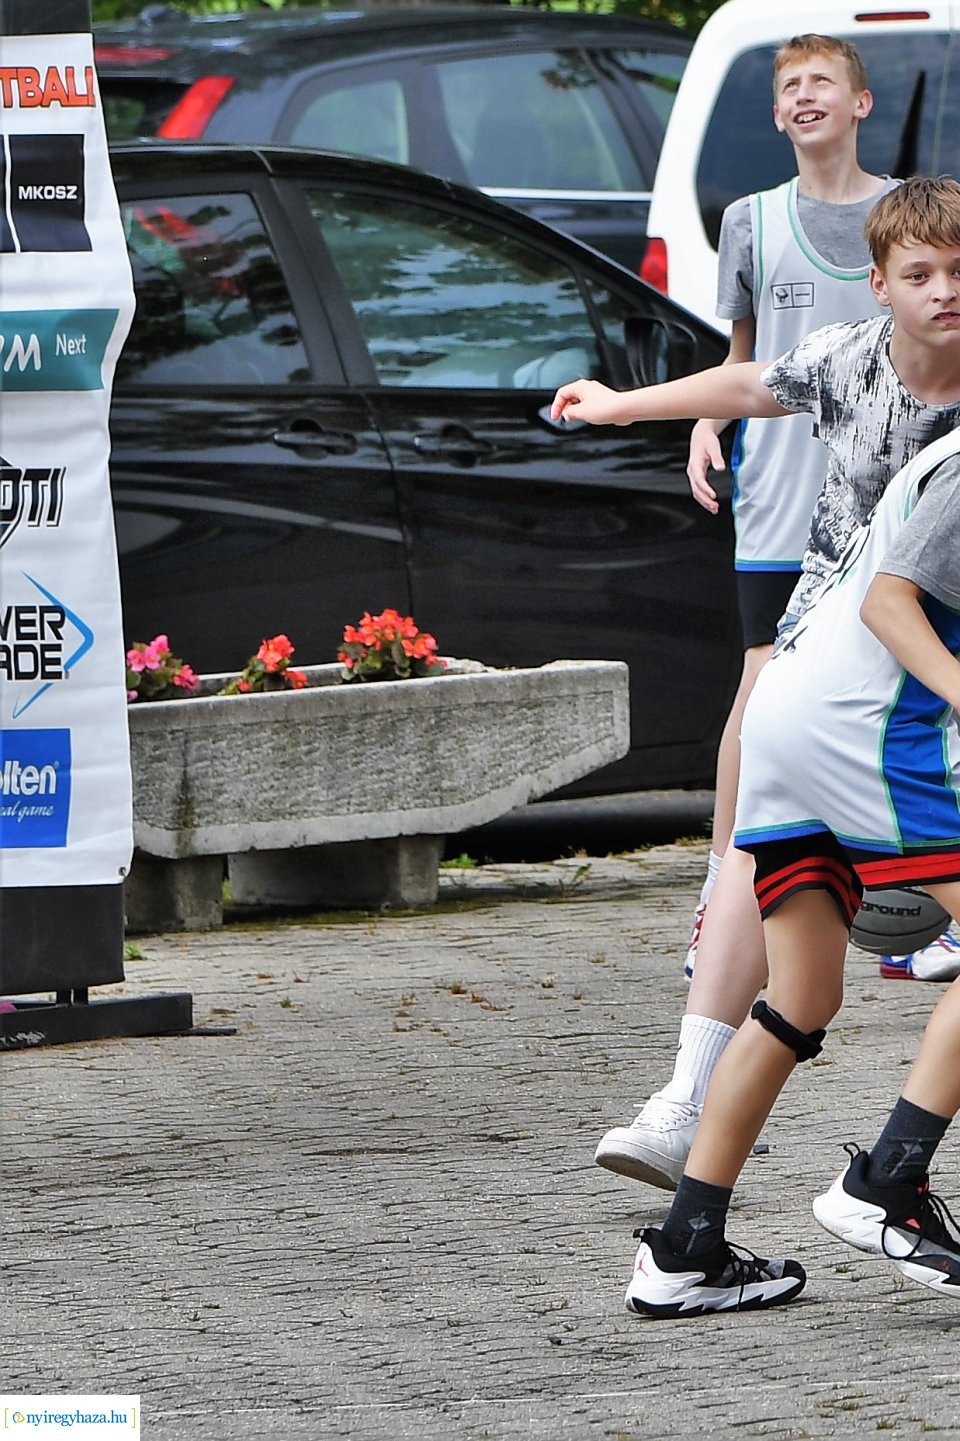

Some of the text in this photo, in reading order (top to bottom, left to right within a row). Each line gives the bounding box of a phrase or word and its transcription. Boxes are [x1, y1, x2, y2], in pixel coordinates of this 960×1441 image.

[18, 185, 78, 200] MKOSZ
[56, 333, 87, 356] Next
[17, 805, 55, 823] game
[861, 901, 922, 917] ground
